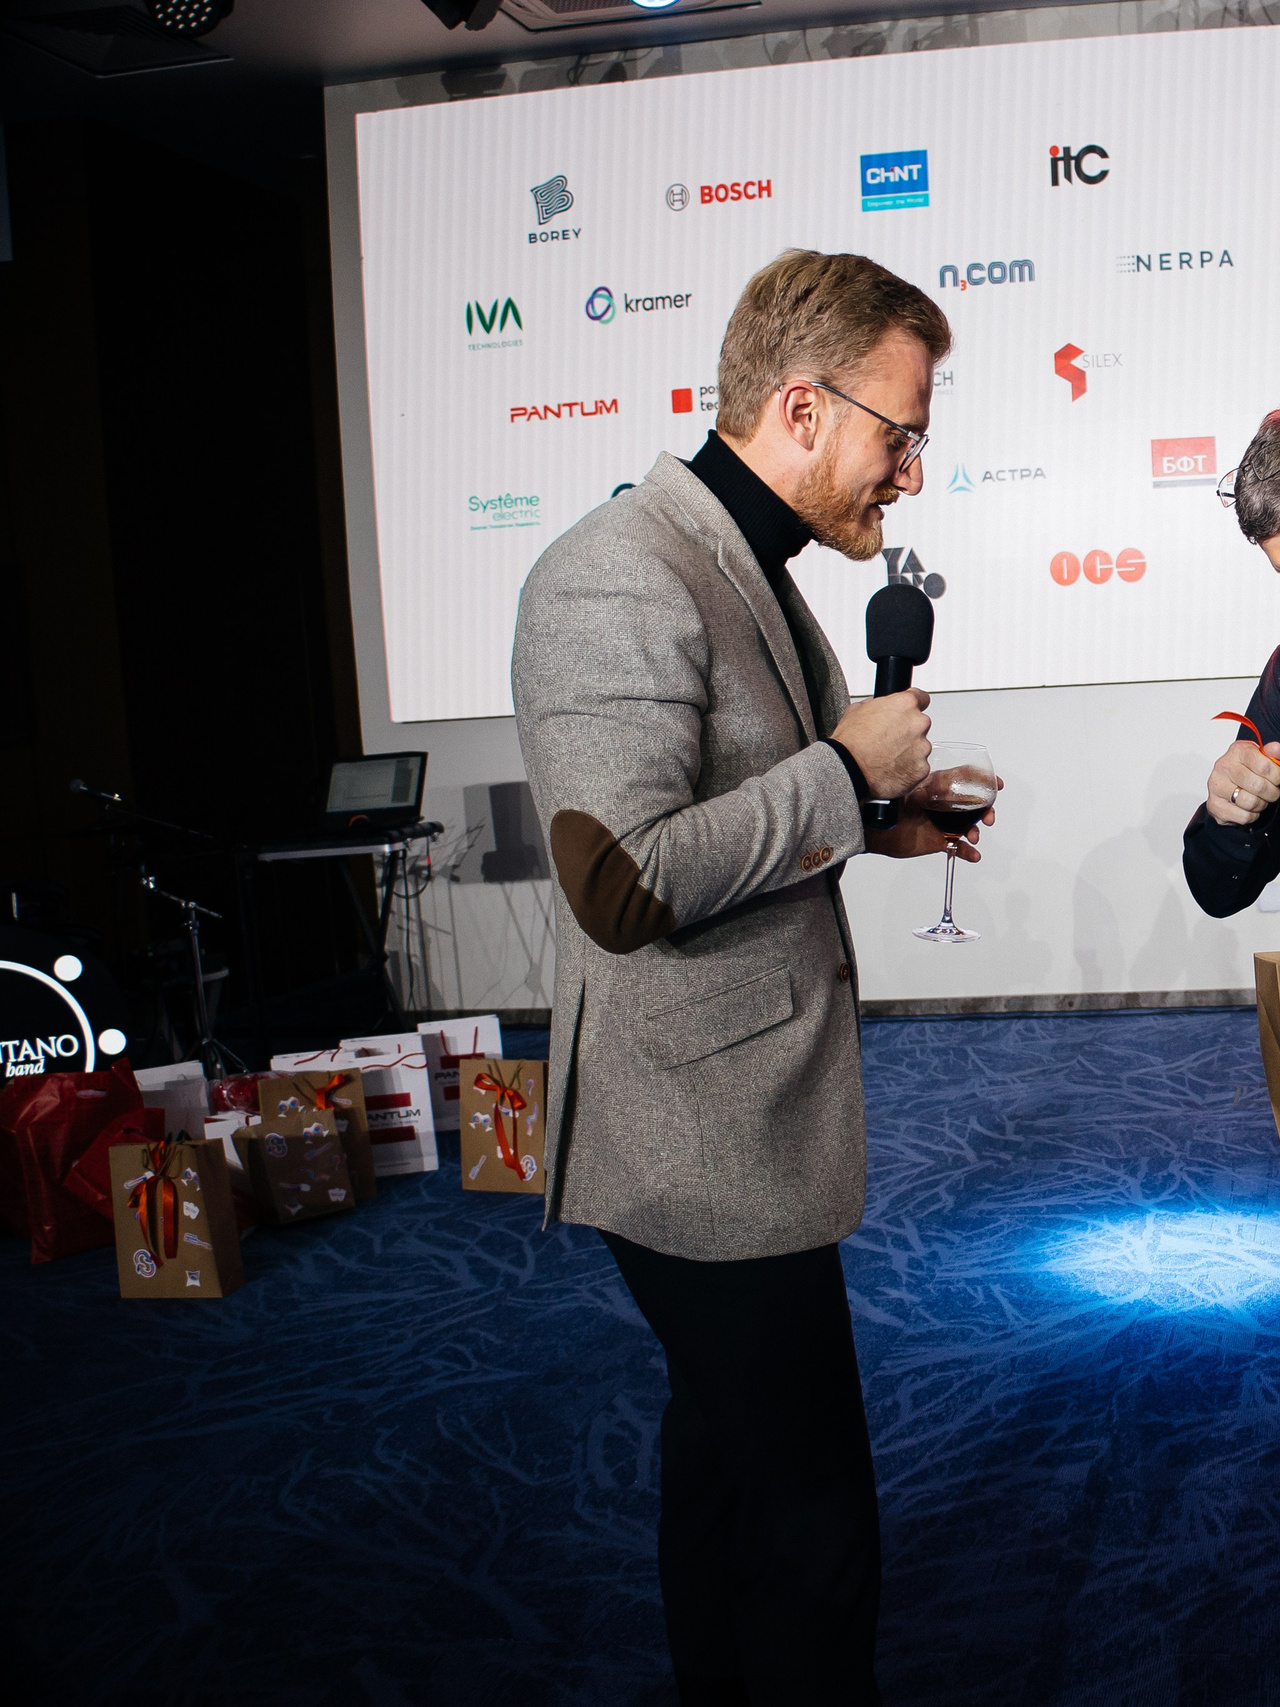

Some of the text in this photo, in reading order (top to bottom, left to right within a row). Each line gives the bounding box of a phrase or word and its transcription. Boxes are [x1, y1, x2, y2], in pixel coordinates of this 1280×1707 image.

[700, 179, 773, 205] BOSCH
[528, 228, 582, 244] BOREY
[1136, 250, 1234, 273] NERPA
[624, 293, 692, 313] kramer
[466, 297, 523, 336] IVA
[1082, 351, 1123, 369] SILEX
[510, 398, 619, 423] PANTUM
[1162, 454, 1207, 474] БФТ
[982, 467, 1046, 483] АСТРА
[0, 1034, 80, 1064] TANO
[5, 1058, 45, 1078] band
